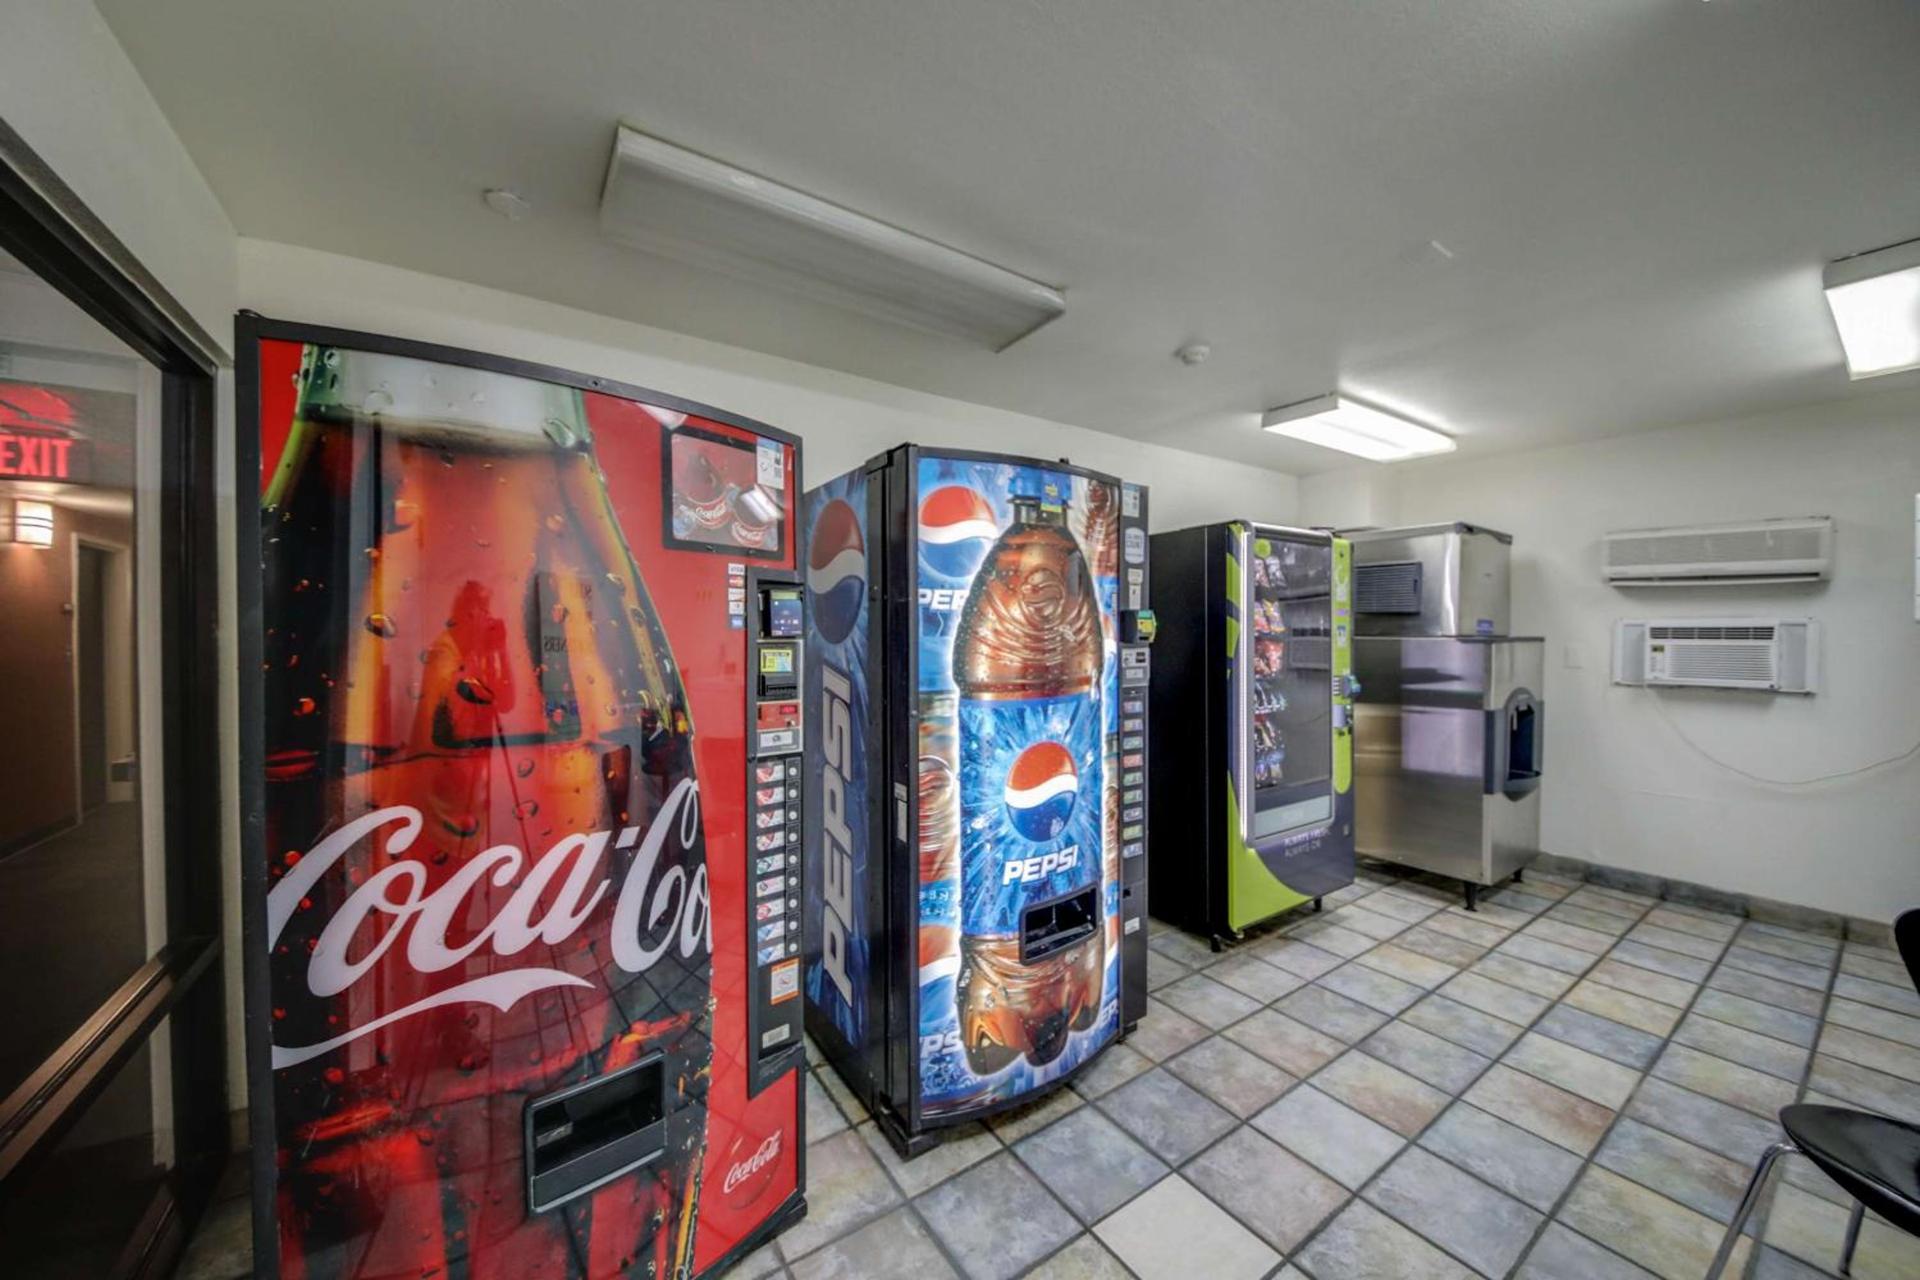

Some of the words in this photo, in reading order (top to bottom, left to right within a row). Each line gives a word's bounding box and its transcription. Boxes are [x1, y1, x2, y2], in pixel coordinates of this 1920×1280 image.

[0, 433, 73, 478] EXIT
[267, 777, 713, 997] Coca-Co
[823, 665, 852, 1008] PEPSI
[1003, 844, 1078, 885] PEPSI
